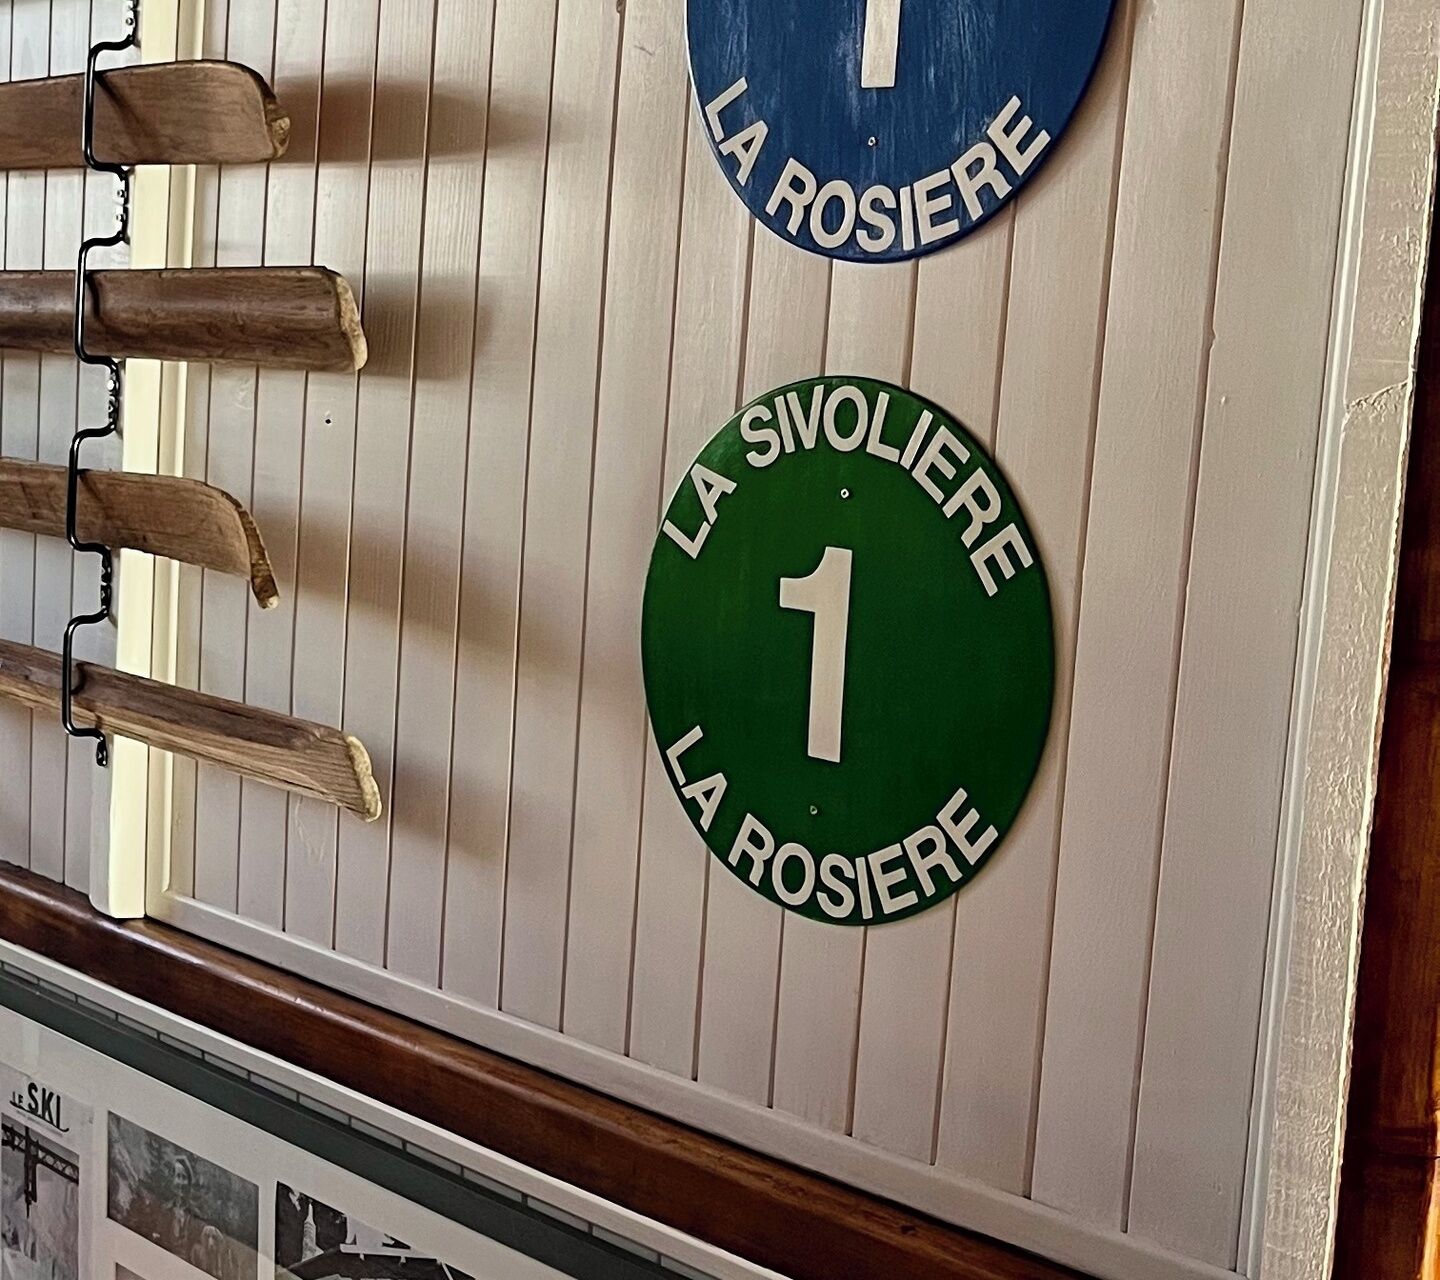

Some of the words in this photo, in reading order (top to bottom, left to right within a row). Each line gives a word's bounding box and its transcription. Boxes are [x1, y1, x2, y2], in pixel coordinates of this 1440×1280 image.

[705, 77, 768, 187] LA
[766, 96, 1051, 253] ROSIERE
[663, 462, 737, 559] LA
[740, 385, 1033, 597] SIVOLIERE
[779, 546, 852, 762] 1
[665, 725, 728, 832] LA
[727, 788, 998, 919] ROSIERE
[27, 1082, 62, 1129] SKI
